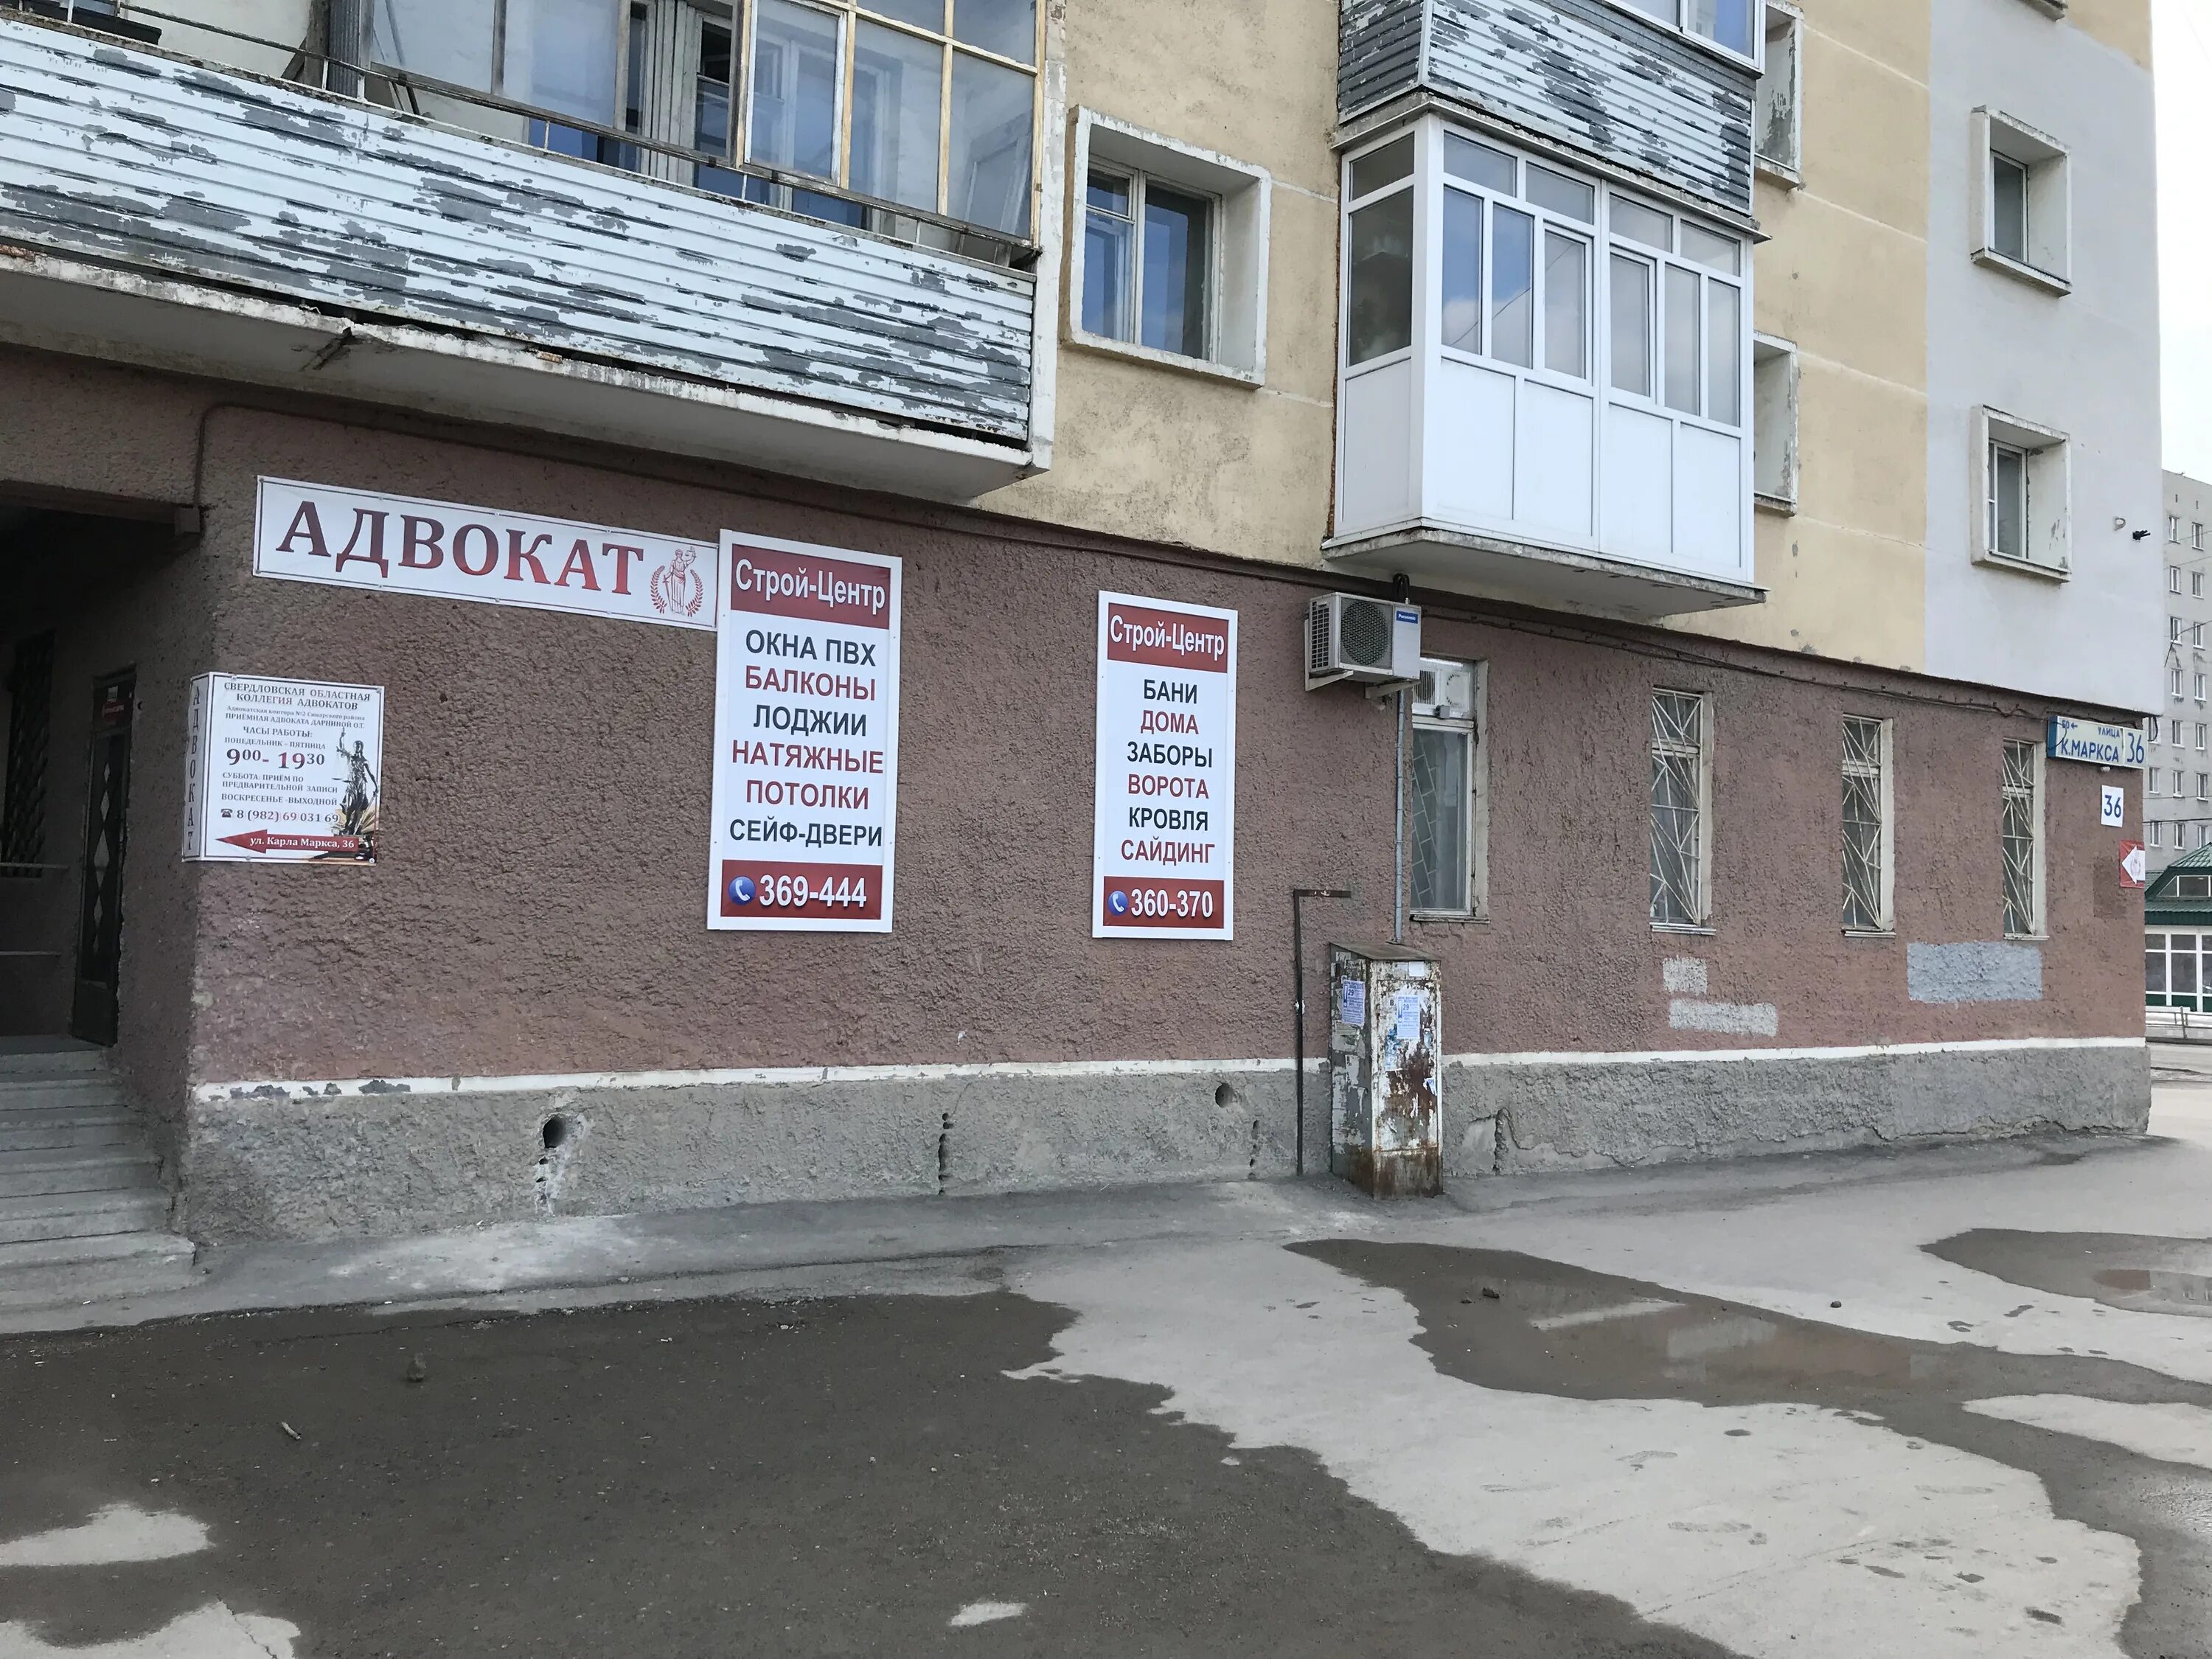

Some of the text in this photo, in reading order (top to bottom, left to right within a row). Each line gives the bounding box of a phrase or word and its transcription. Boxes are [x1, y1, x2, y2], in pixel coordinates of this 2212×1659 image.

[276, 500, 644, 597] АДВОКАТ
[736, 558, 886, 616] Строй-Центр
[745, 629, 876, 667] ОКНА ПВХ
[1110, 614, 1225, 662] Строй-Центр
[224, 681, 371, 702] СВЕРДЛОВСКАЯ ОБЛАСТНАЯ
[745, 664, 876, 701] БАЛКОНЫ
[1144, 678, 1198, 705] БАНИ
[227, 705, 268, 714] Адвокатская
[268, 709, 295, 717] контора
[307, 712, 343, 720] Синарского
[236, 693, 358, 710] КОЛЛЕГИЯ АДВОКАТОВ
[243, 726, 313, 738] ЧАСЫ РАБОТЫ:
[270, 716, 310, 726] АДВОКАТА
[753, 703, 867, 737] ЛОДЖИИ
[1140, 709, 1200, 735] ДОМА
[2097, 726, 2121, 739] УЛИЦА
[224, 737, 283, 747] ПОНЕДЕЛЬНИК
[290, 741, 327, 750] ПЯТНИЦА
[731, 739, 884, 774] НАТЯЖНЫЕ
[1127, 741, 1213, 768] ЗАБОРЫ
[2126, 732, 2145, 764] 36
[221, 793, 284, 803] ВОСКРЕСЕНЬЕ
[222, 781, 338, 793] ПРЕДВАРИТЕЛЬНОЙ ЗАПИСИ
[745, 779, 869, 810] ПОТОЛКИ
[1127, 773, 1210, 799] ВОРОТА
[237, 810, 339, 824] 8 (982) 69 031 69
[1129, 807, 1208, 831] КРОВЛЯ
[2103, 794, 2121, 818] 36
[249, 837, 355, 849] ул. Карла Маркса, 36
[729, 815, 883, 849] СЕЙФ-ДВЕРИ
[1121, 835, 1216, 867] САЙДИНГ
[759, 874, 867, 908] 369-444
[1131, 888, 1214, 919] 360-370
